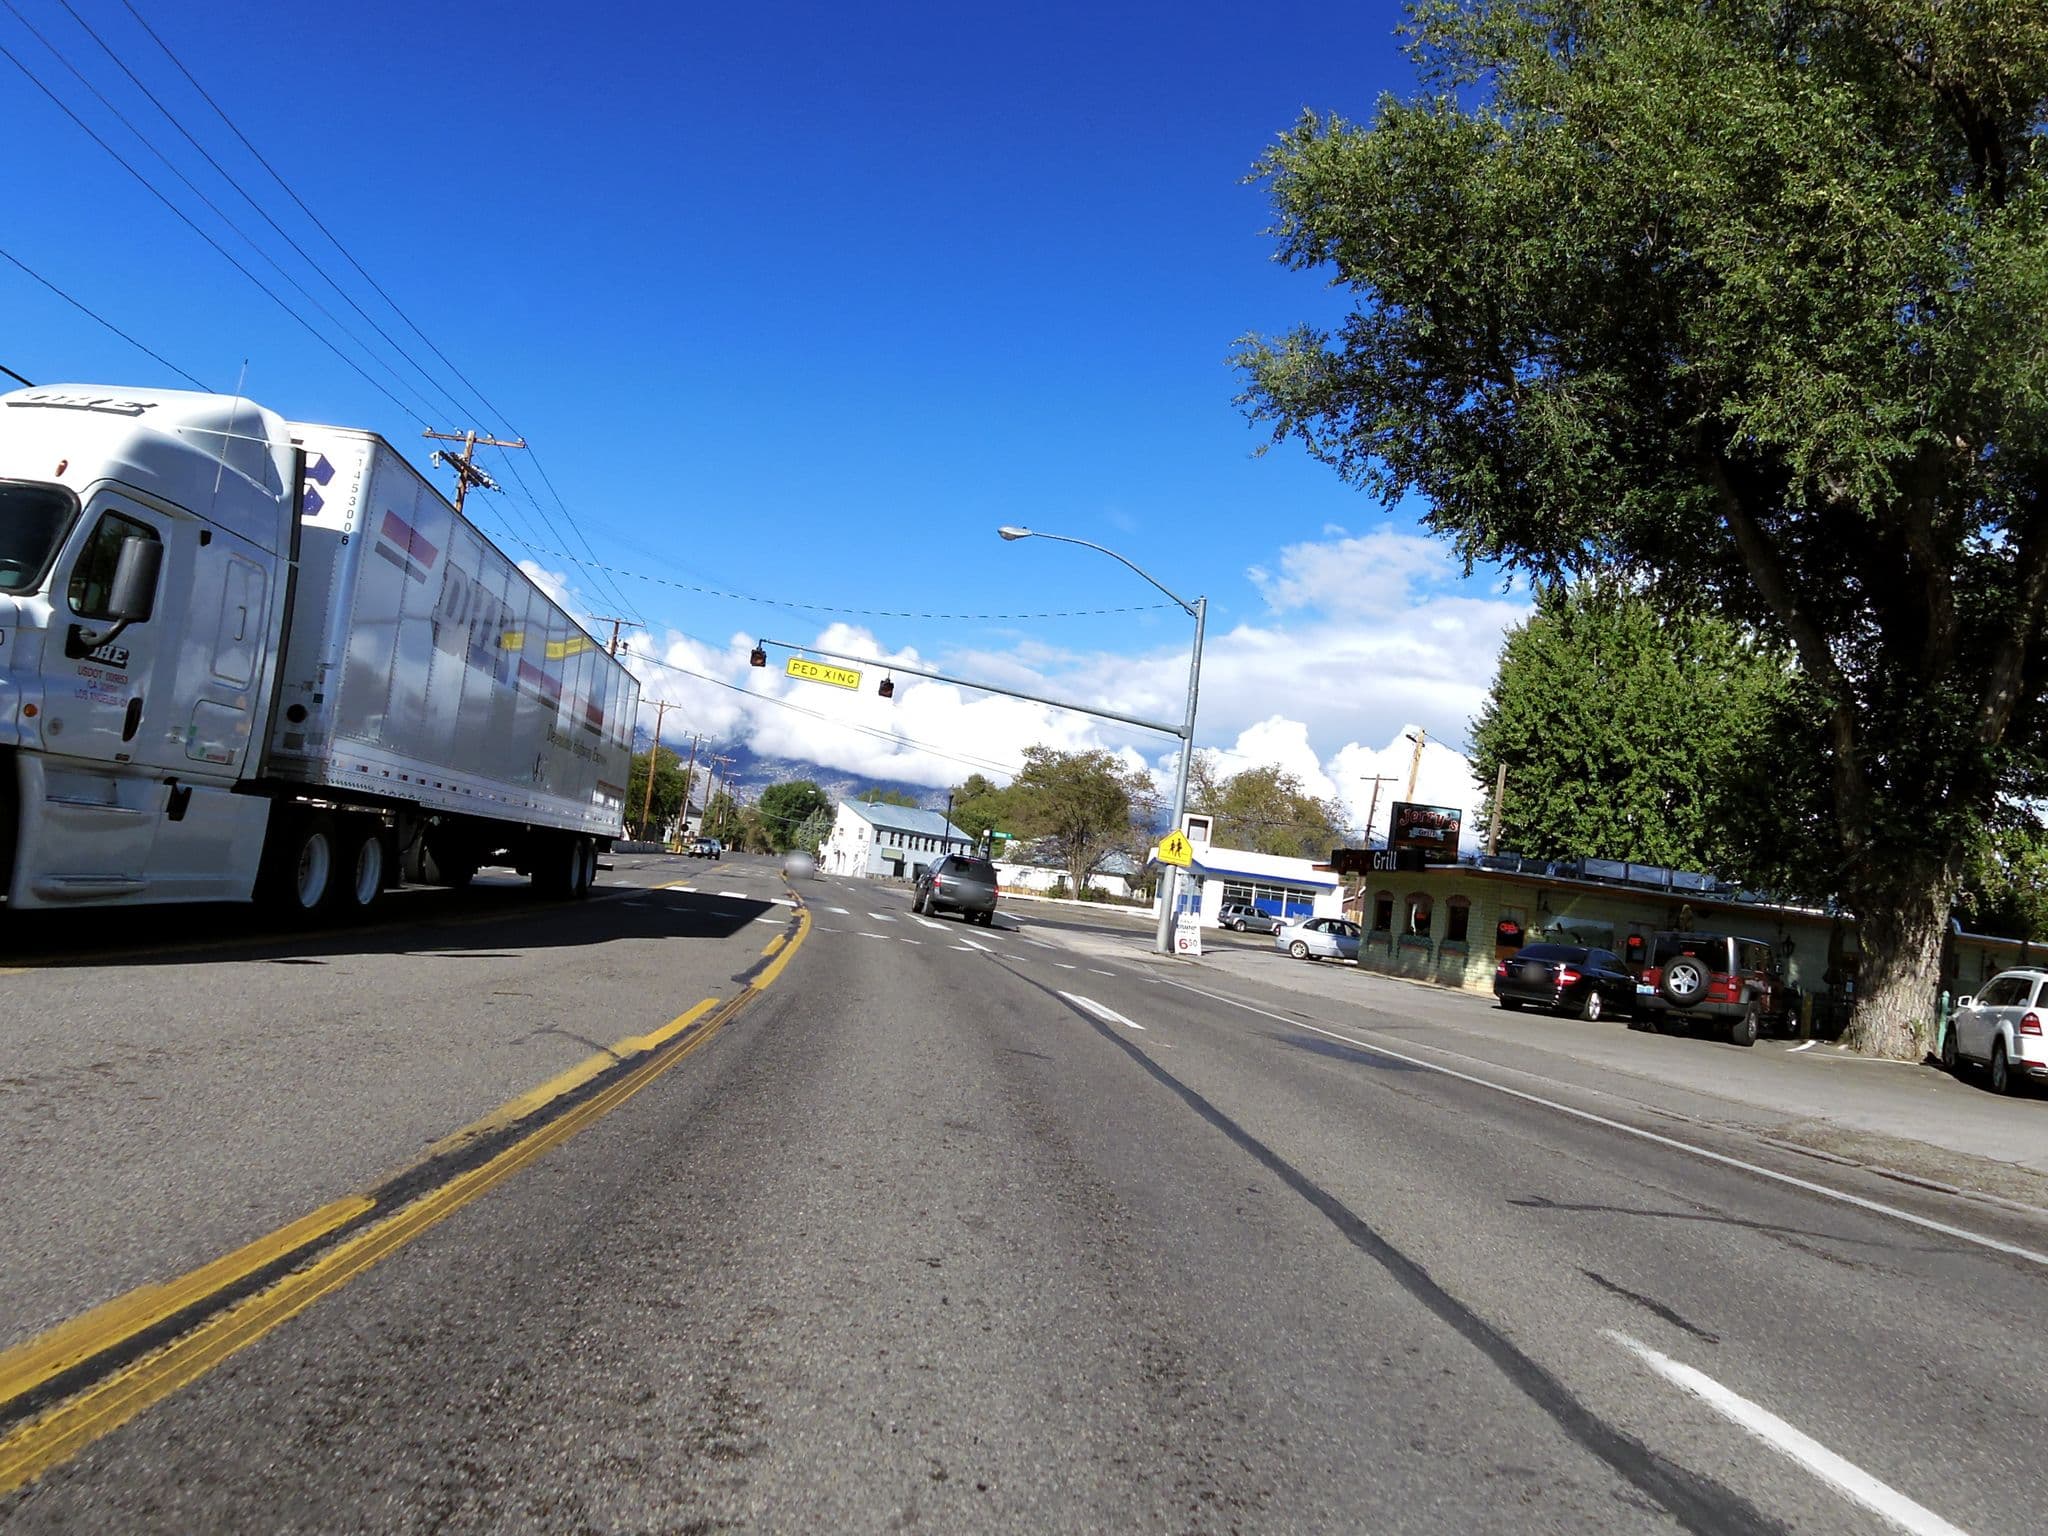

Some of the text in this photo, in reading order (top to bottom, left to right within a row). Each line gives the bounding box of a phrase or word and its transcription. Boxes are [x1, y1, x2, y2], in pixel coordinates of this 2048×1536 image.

[793, 663, 855, 684] PED XING
[1373, 851, 1397, 870] Grill
